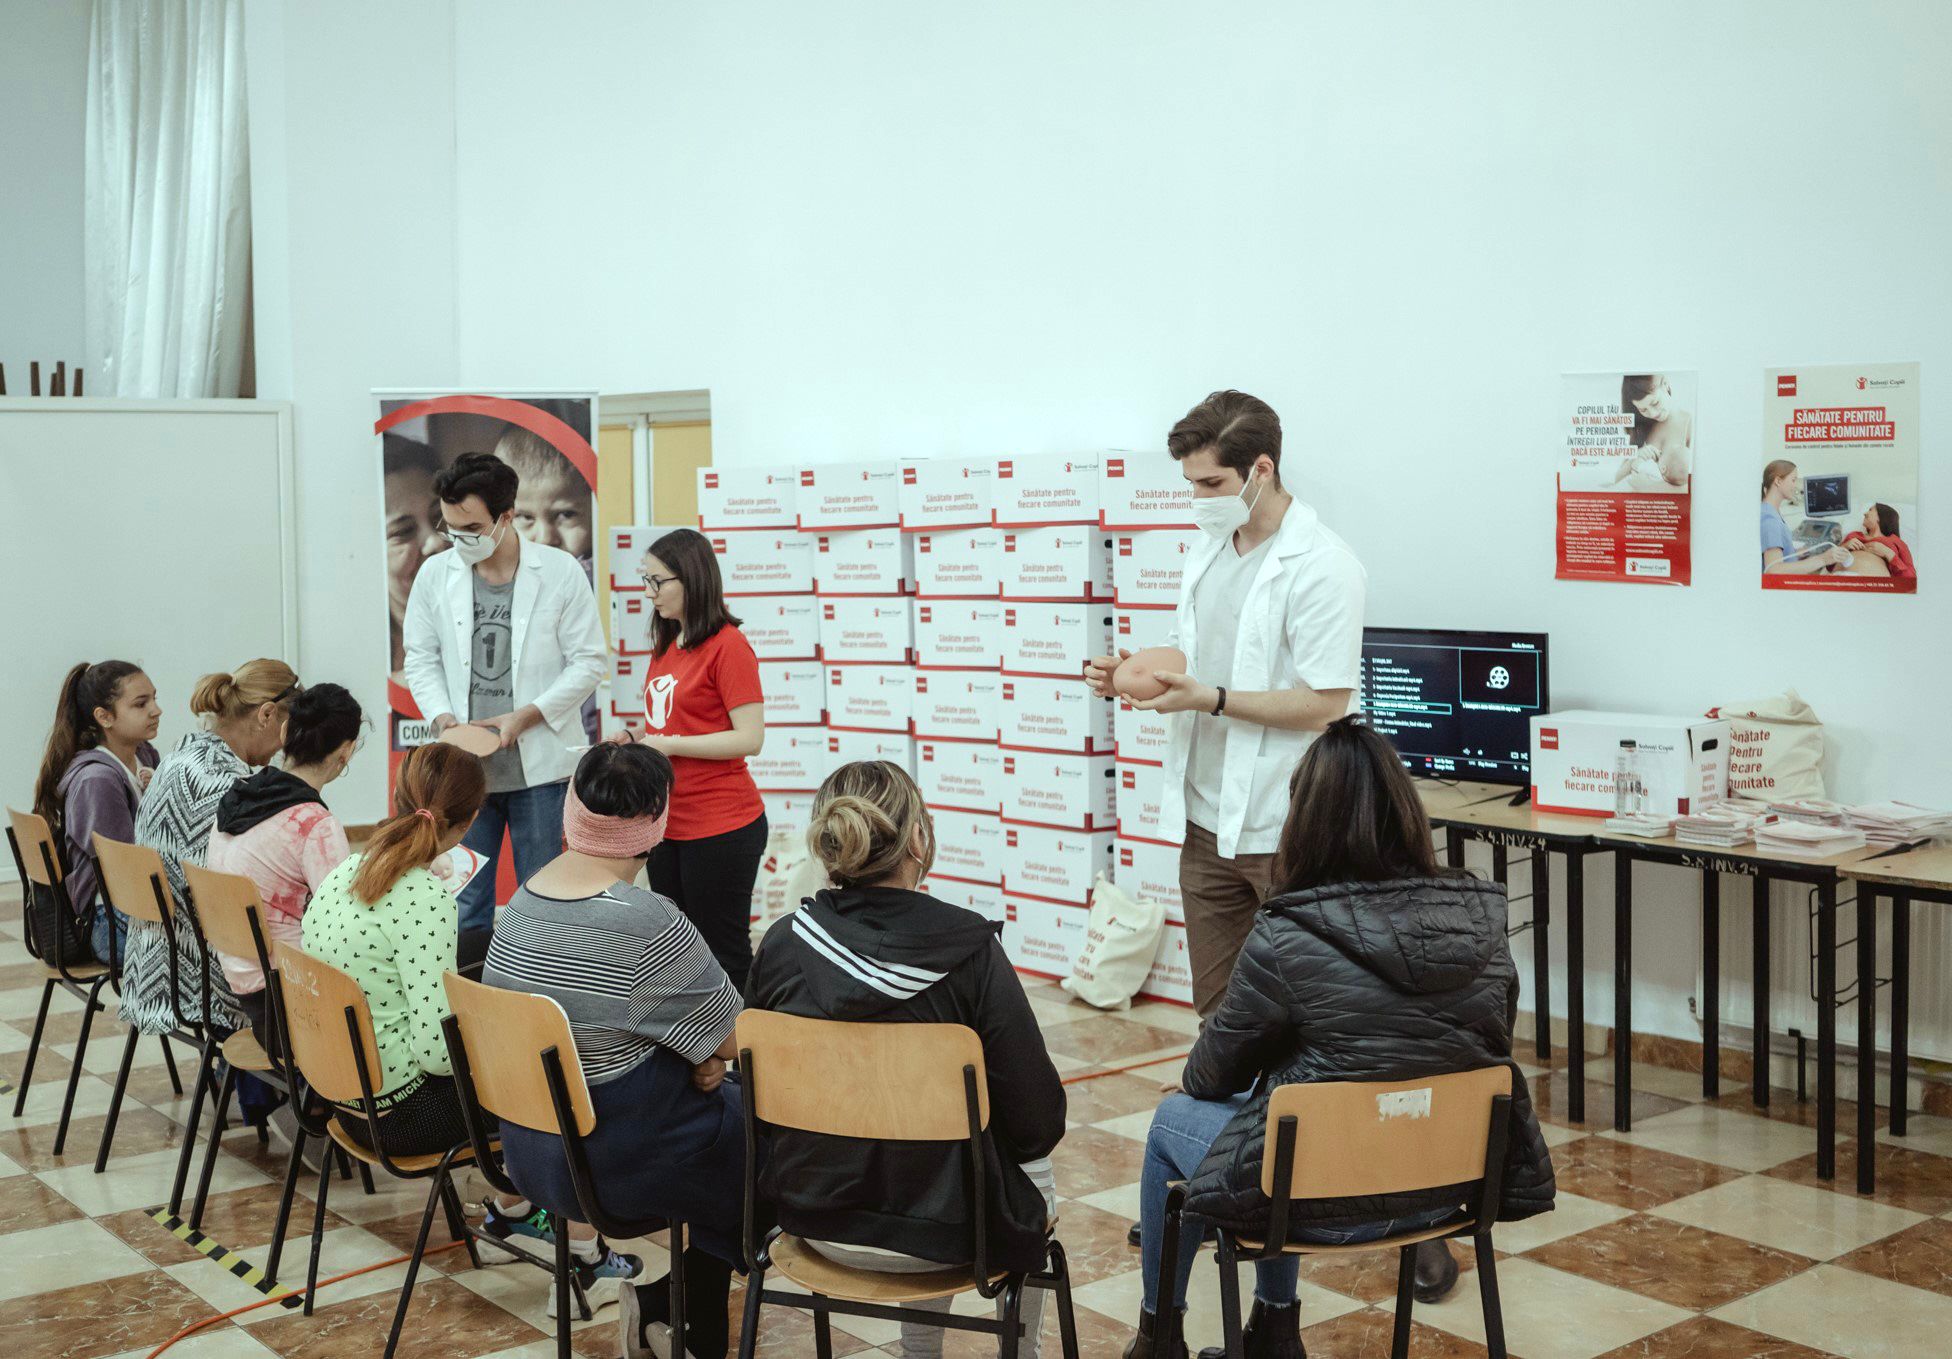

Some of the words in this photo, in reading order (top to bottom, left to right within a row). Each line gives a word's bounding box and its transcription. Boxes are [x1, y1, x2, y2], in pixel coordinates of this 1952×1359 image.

[1577, 406, 1604, 414] COPILUL
[1572, 416, 1580, 424] VA
[1590, 416, 1601, 424] MAI
[1796, 409, 1841, 424] SĂNĂTATE
[1844, 410, 1882, 423] PENTRU
[1586, 427, 1618, 435] PERIOADA
[1788, 426, 1828, 439] FIECARE
[1830, 425, 1891, 438] COMUNITATE
[1571, 447, 1588, 456] DACĂ
[1590, 448, 1605, 456] ESTE
[1022, 489, 1051, 497] Sănătate
[1135, 490, 1169, 498] Sănătate
[482, 632, 496, 668] 1
[403, 726, 431, 740] COM
[1730, 730, 1770, 743] ănătate
[1570, 766, 1609, 780] Sănătate
[1731, 762, 1762, 774] ecare
[1565, 779, 1595, 792] fiecare
[1733, 776, 1775, 789] unitate
[376, 1098, 392, 1109] AM
